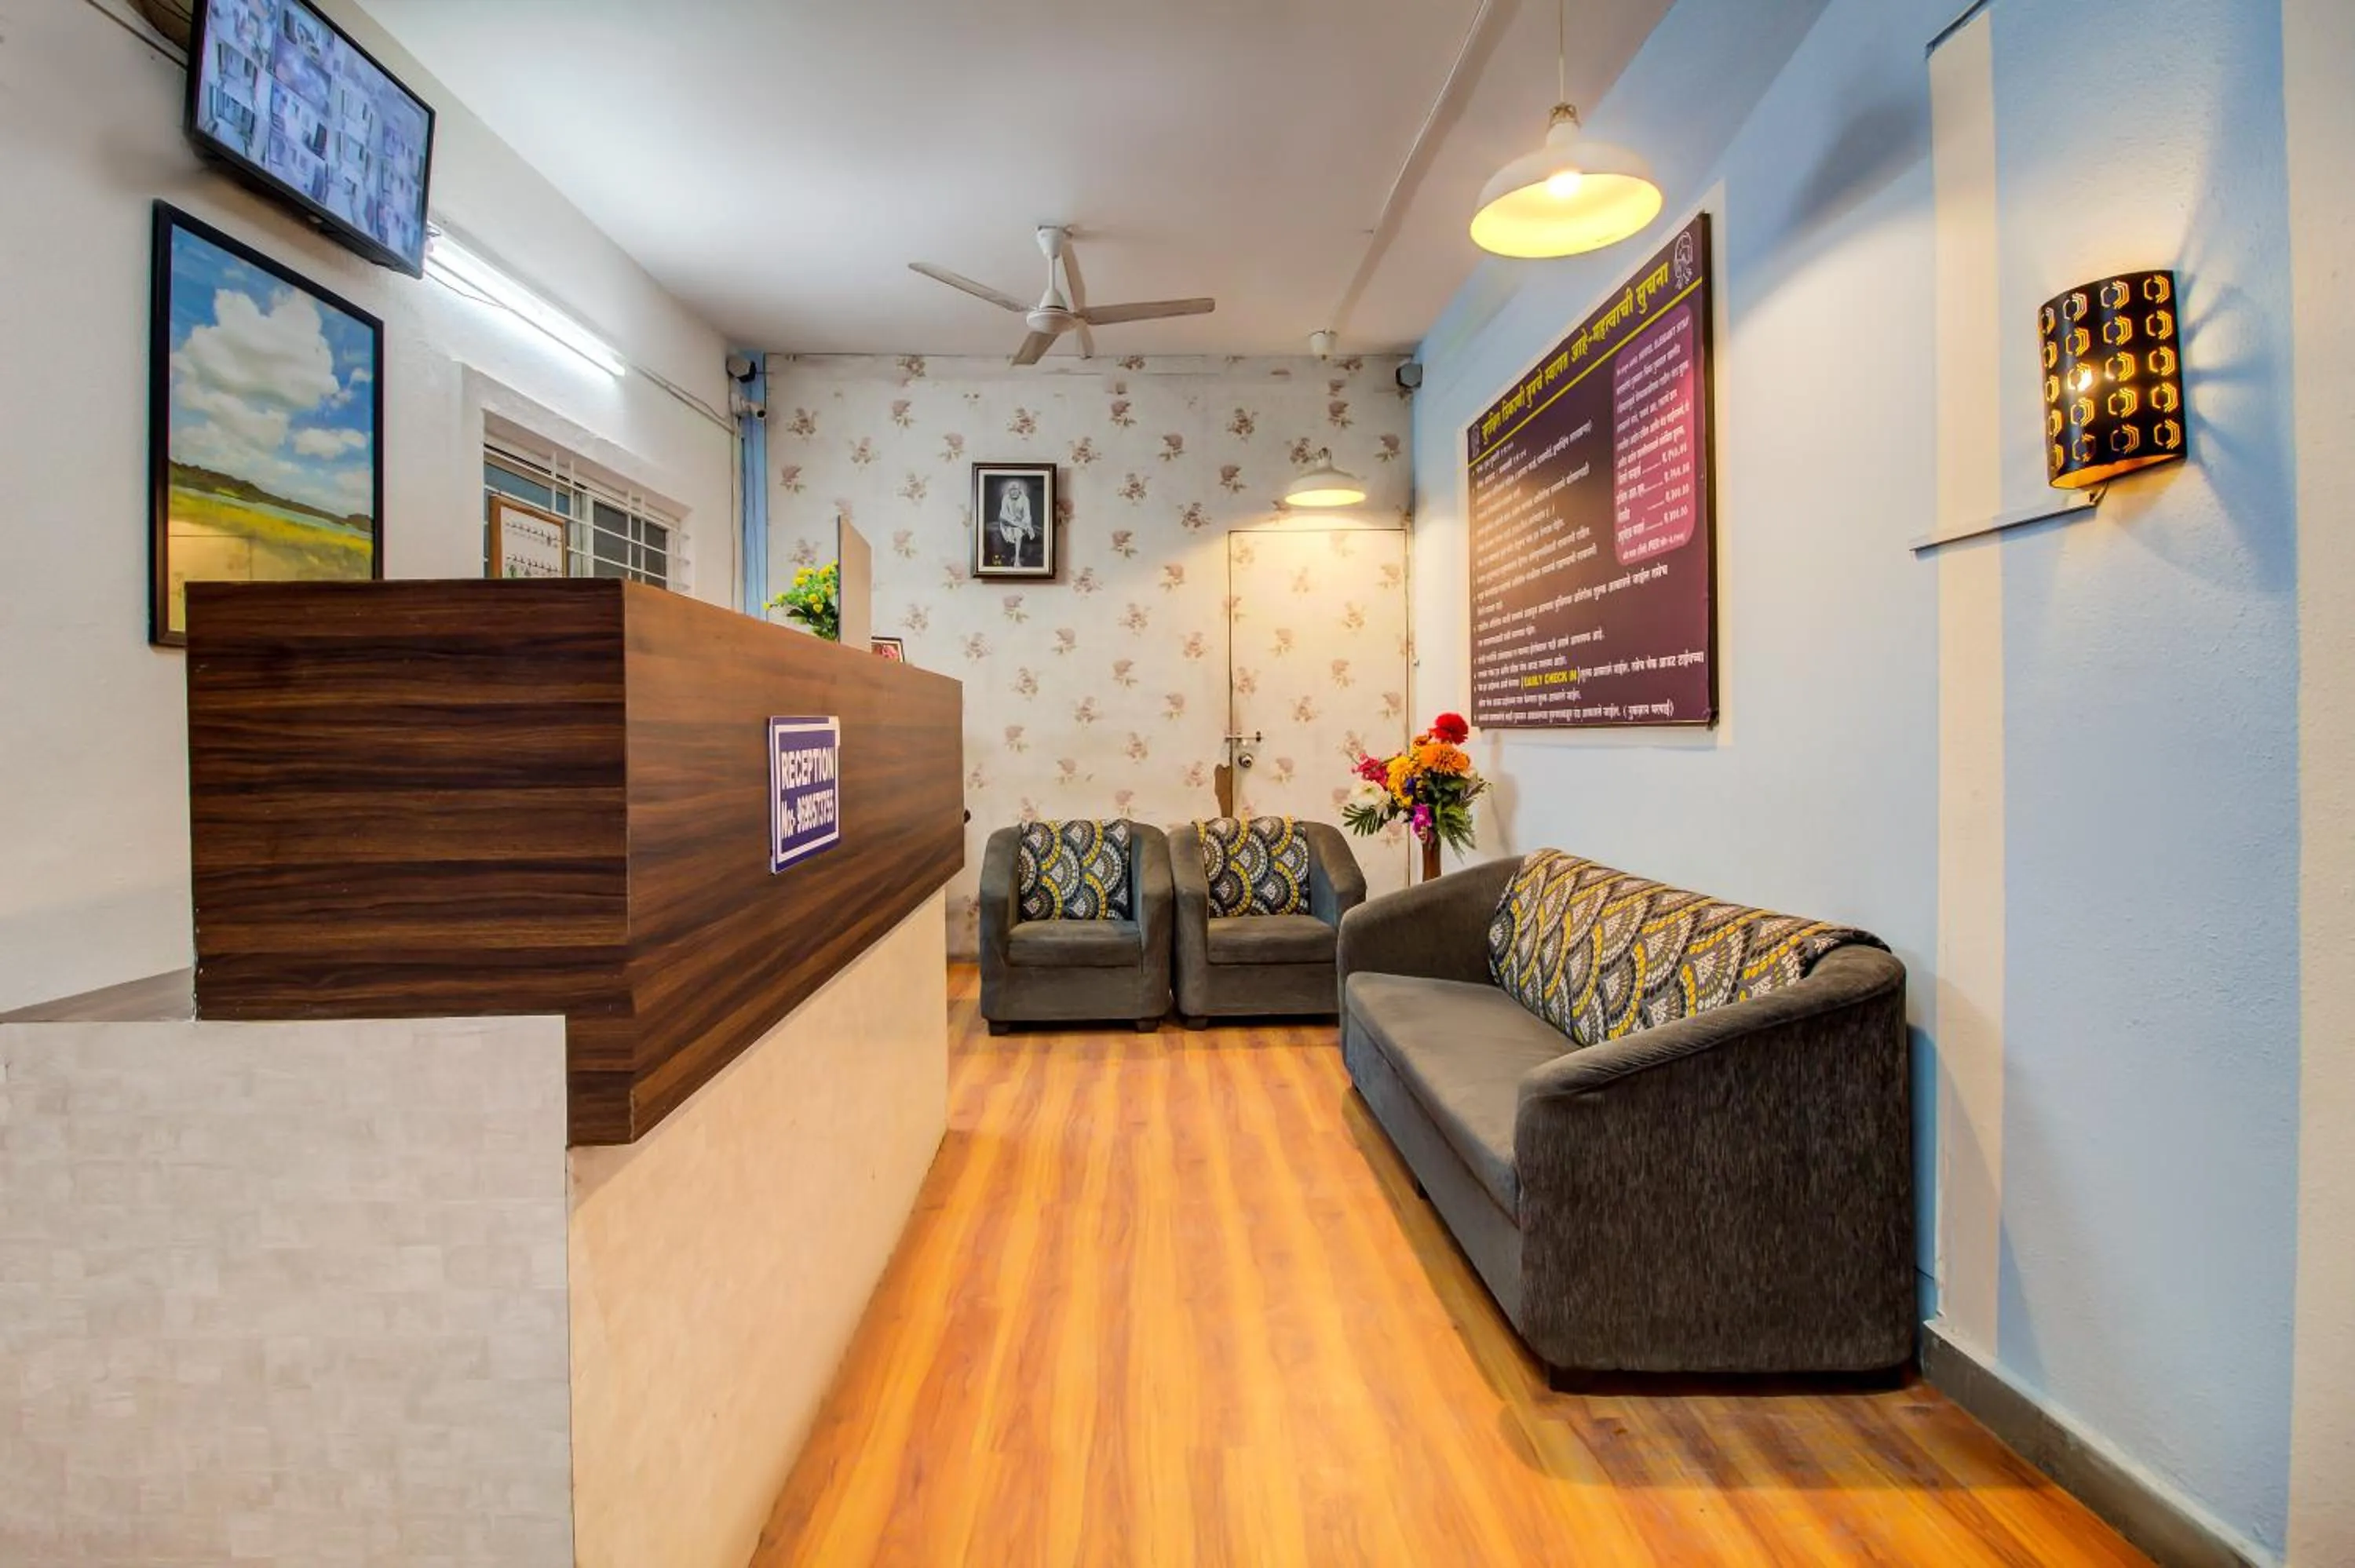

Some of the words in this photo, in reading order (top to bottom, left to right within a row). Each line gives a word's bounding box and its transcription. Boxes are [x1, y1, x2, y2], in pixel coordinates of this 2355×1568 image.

[1636, 261, 1669, 315] सुचना
[1544, 671, 1568, 685] CHECK
[782, 747, 834, 790] RECEPTION
